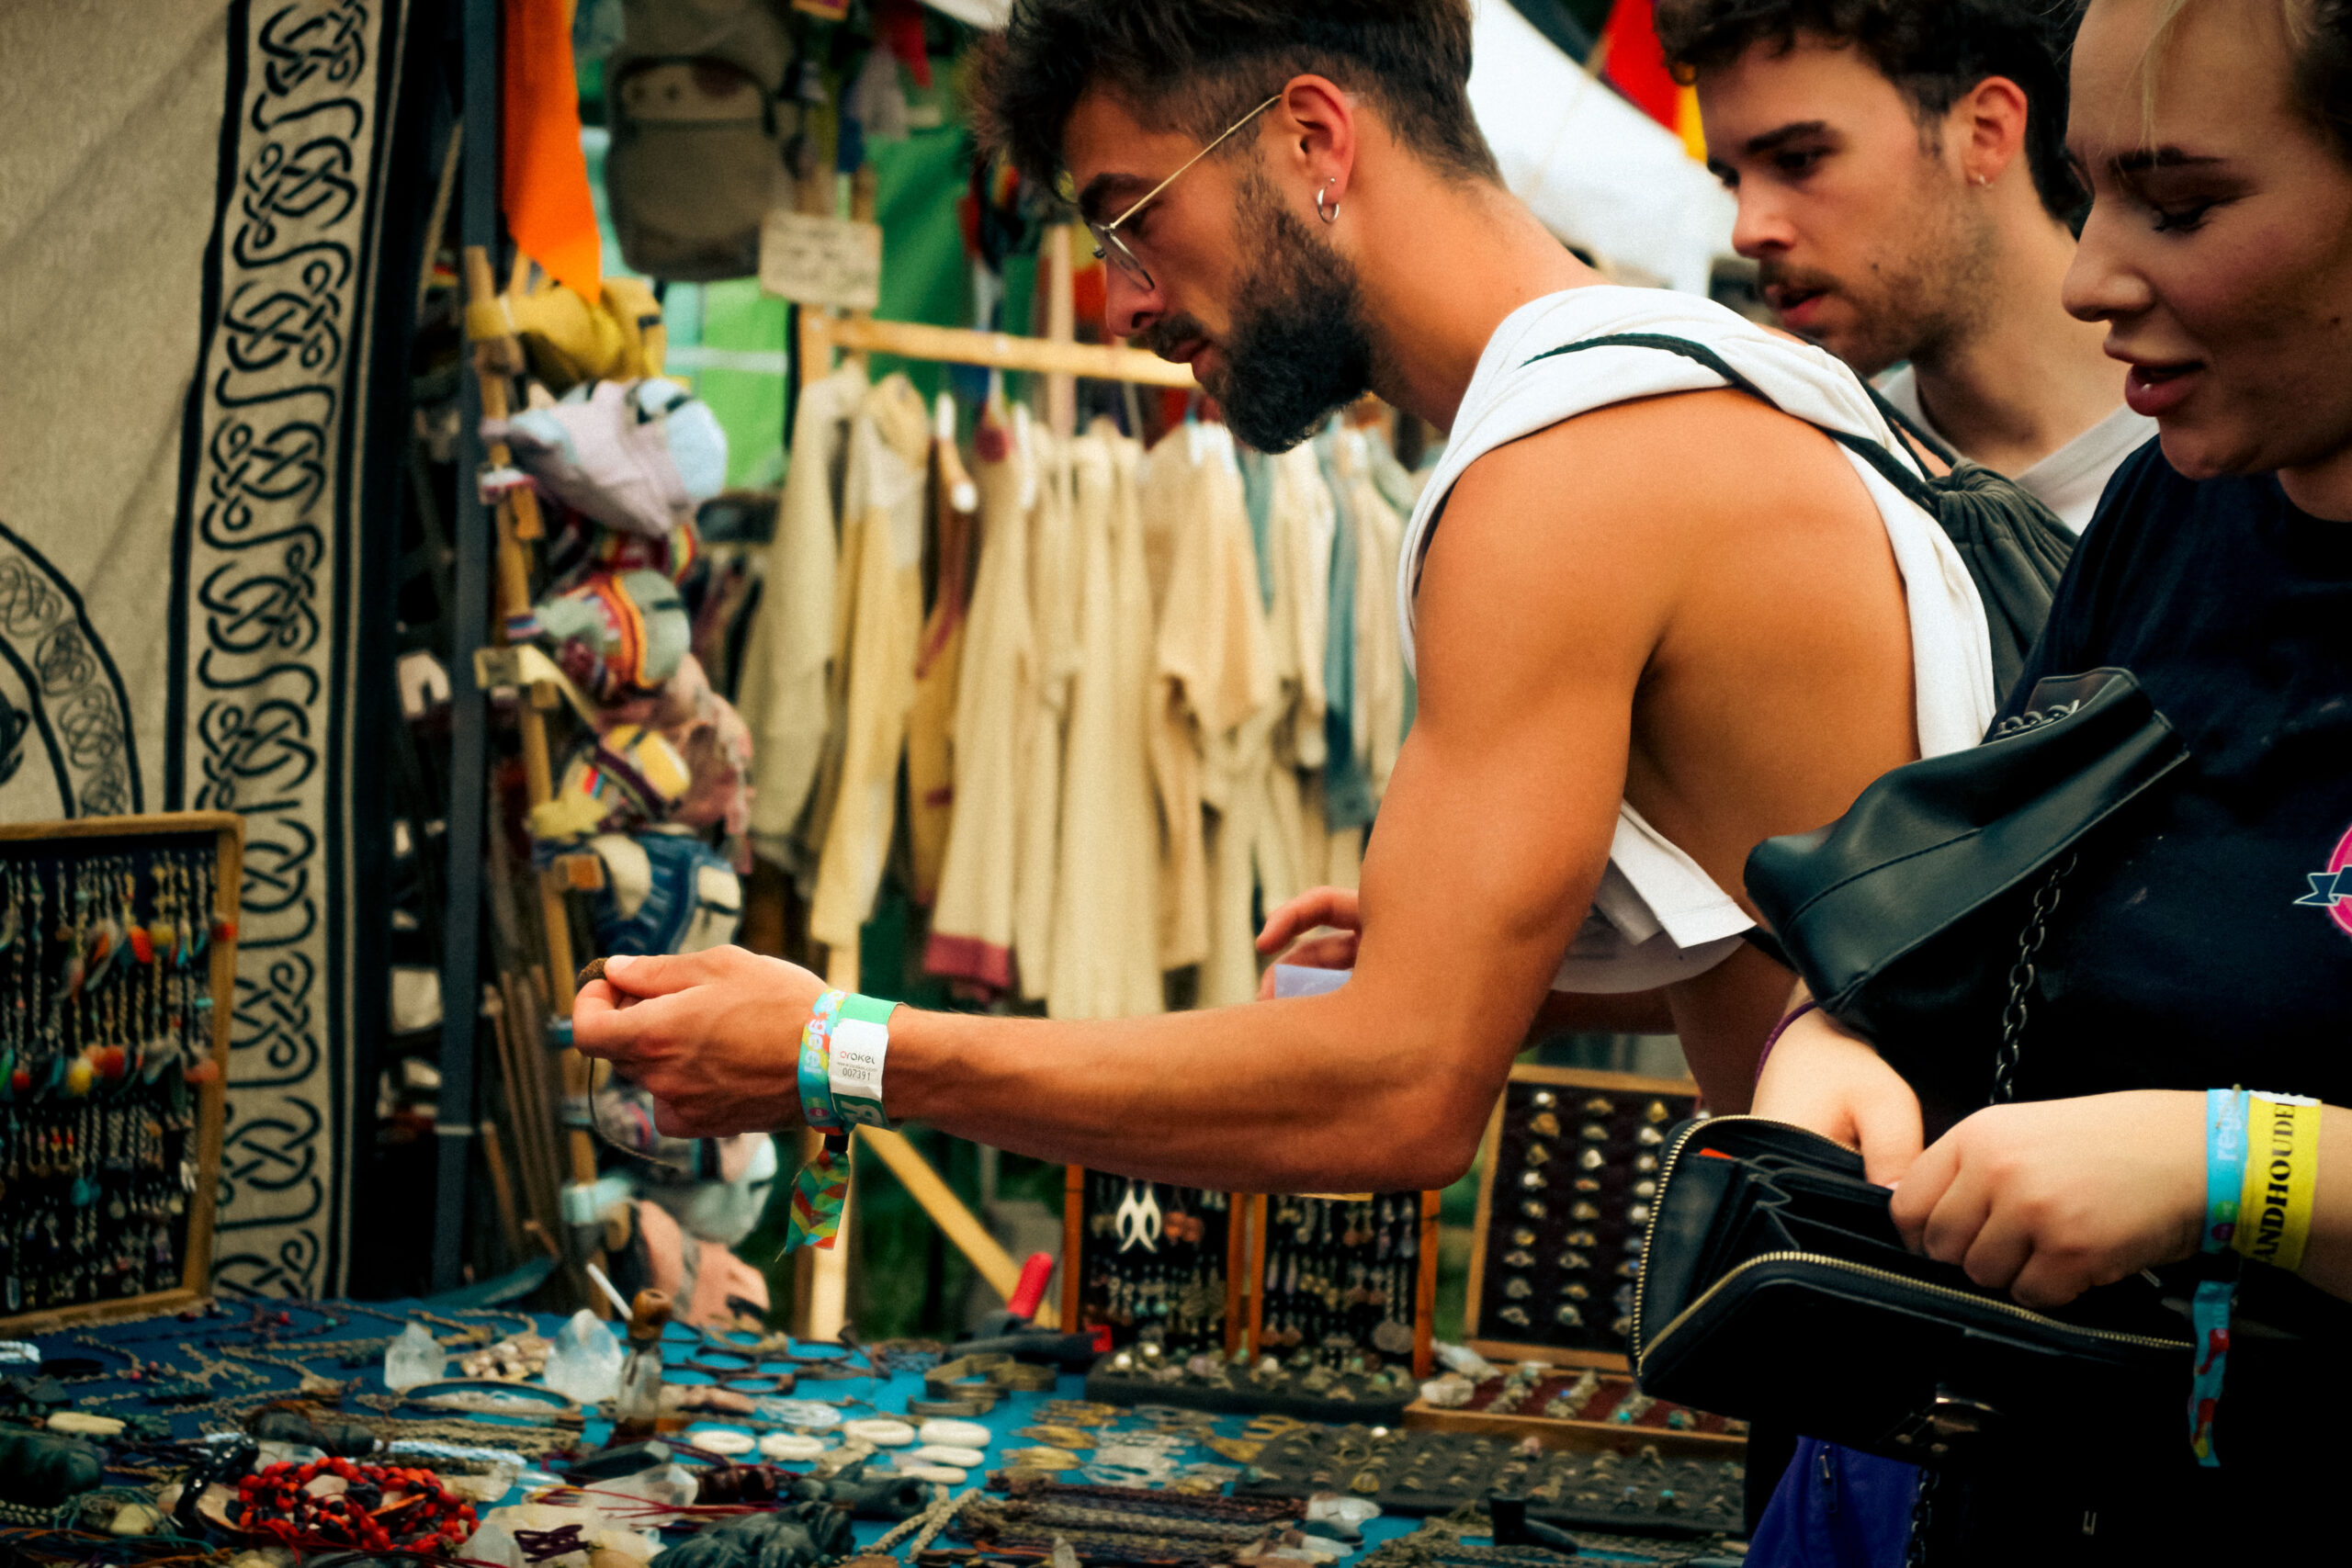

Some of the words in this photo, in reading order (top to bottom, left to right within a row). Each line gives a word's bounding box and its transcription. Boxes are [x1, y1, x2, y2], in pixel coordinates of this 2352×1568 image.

[804, 1019, 827, 1074] geel
[840, 1051, 875, 1064] orakel
[842, 1067, 870, 1081] 007391
